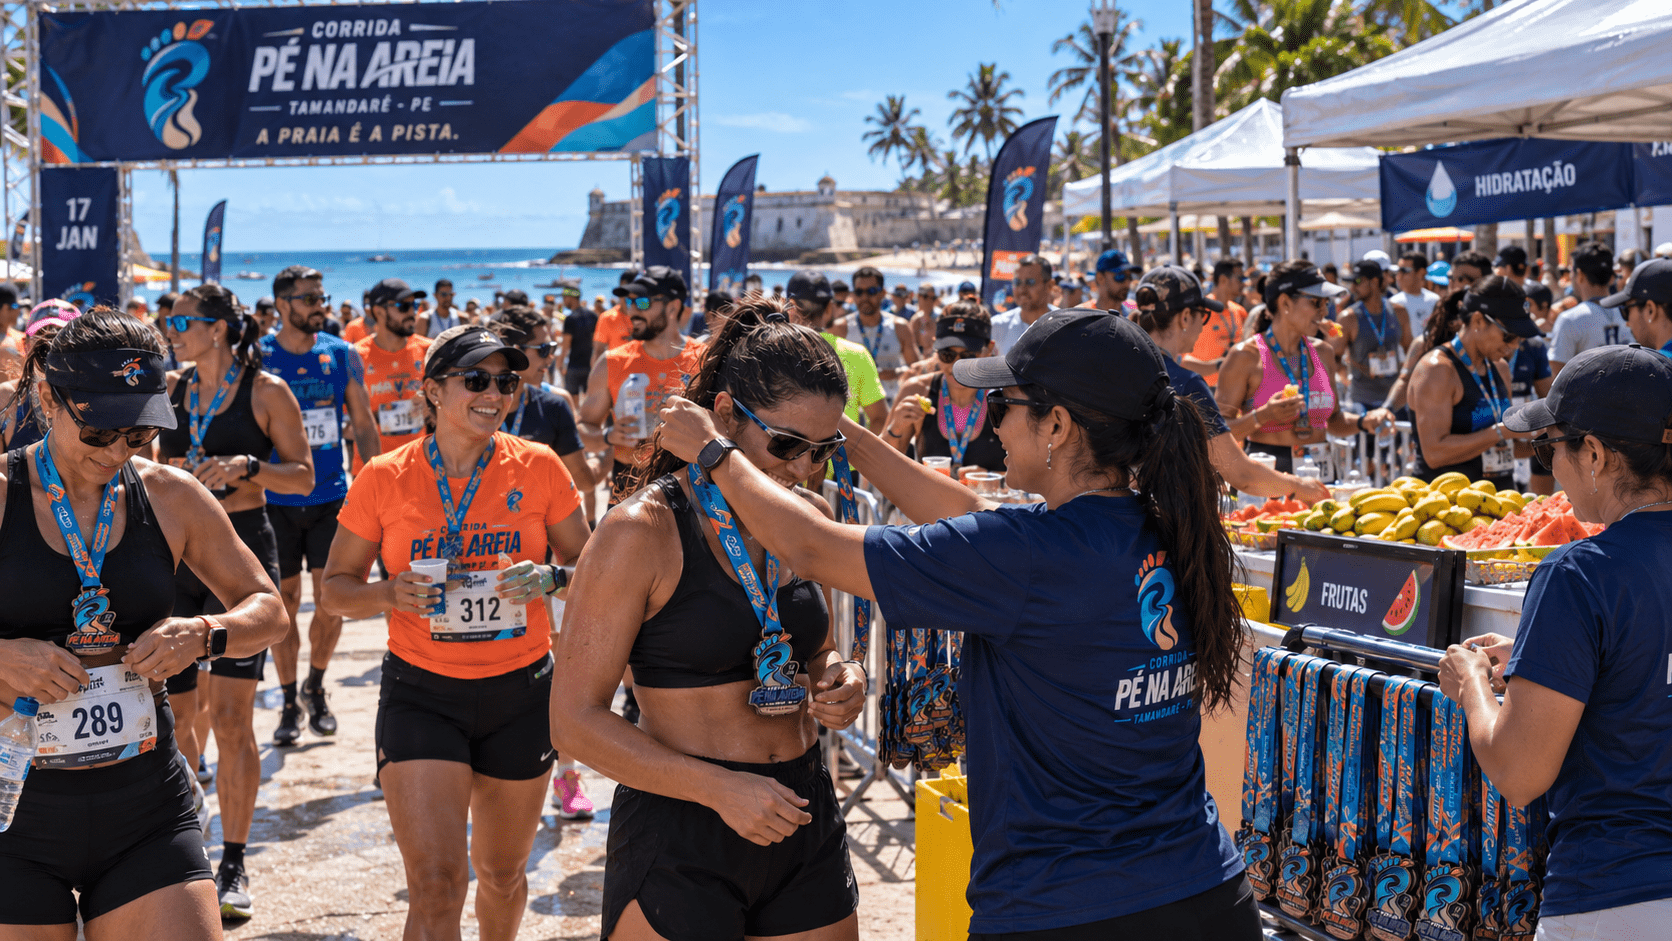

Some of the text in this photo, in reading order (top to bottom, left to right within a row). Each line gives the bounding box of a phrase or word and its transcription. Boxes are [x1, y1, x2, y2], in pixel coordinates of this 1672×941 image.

[311, 18, 401, 39] CORRIDA
[248, 36, 476, 92] PÉ NA AREIA
[289, 94, 392, 116] TAMANDARÉ
[410, 96, 433, 112] PE
[256, 121, 459, 145] A PRAIA É A PISTA.
[1474, 159, 1577, 198] HIDRATAÇÃO
[65, 197, 92, 222] 17
[55, 225, 99, 251] JAN
[441, 522, 487, 534] CRIDA
[410, 533, 434, 562] PÉ
[466, 530, 521, 558] AREIA
[460, 596, 501, 623] 312
[1320, 581, 1369, 615] FRUTAS
[1149, 650, 1188, 670] CORRIDA
[1114, 660, 1199, 711] PÉ NA ARE
[72, 701, 124, 740] 289
